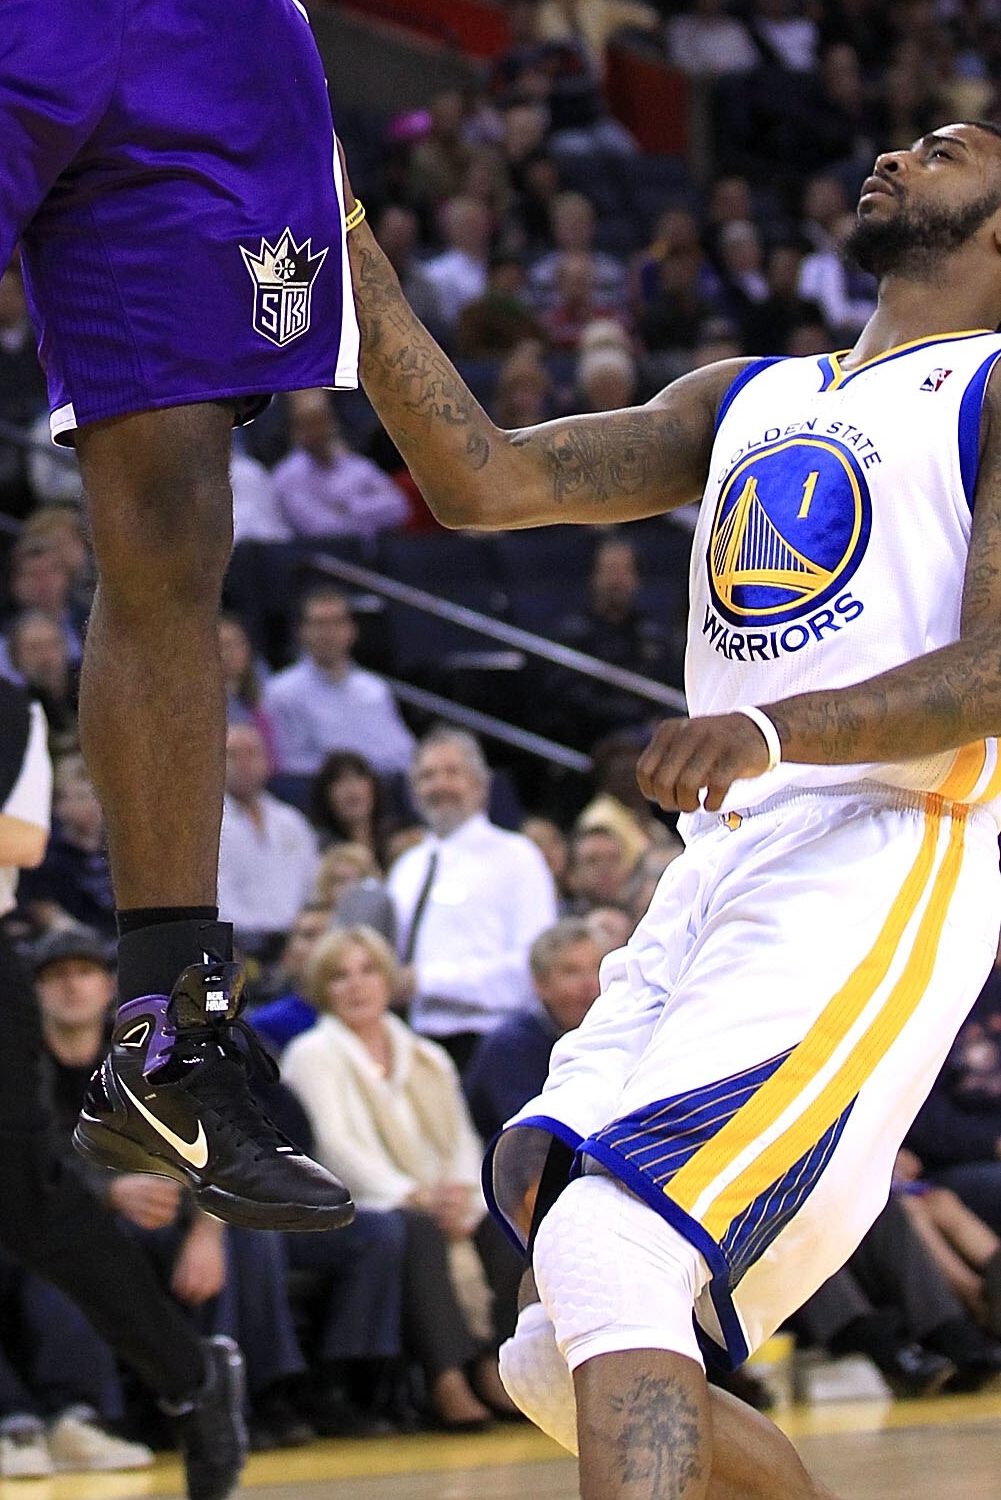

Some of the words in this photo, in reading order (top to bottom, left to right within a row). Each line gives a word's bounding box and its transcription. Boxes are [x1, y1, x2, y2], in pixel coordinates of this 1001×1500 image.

[717, 418, 818, 483] GOLDEN
[826, 421, 882, 469] STATE
[796, 471, 820, 519] 1
[702, 592, 865, 662] WARRIORS
